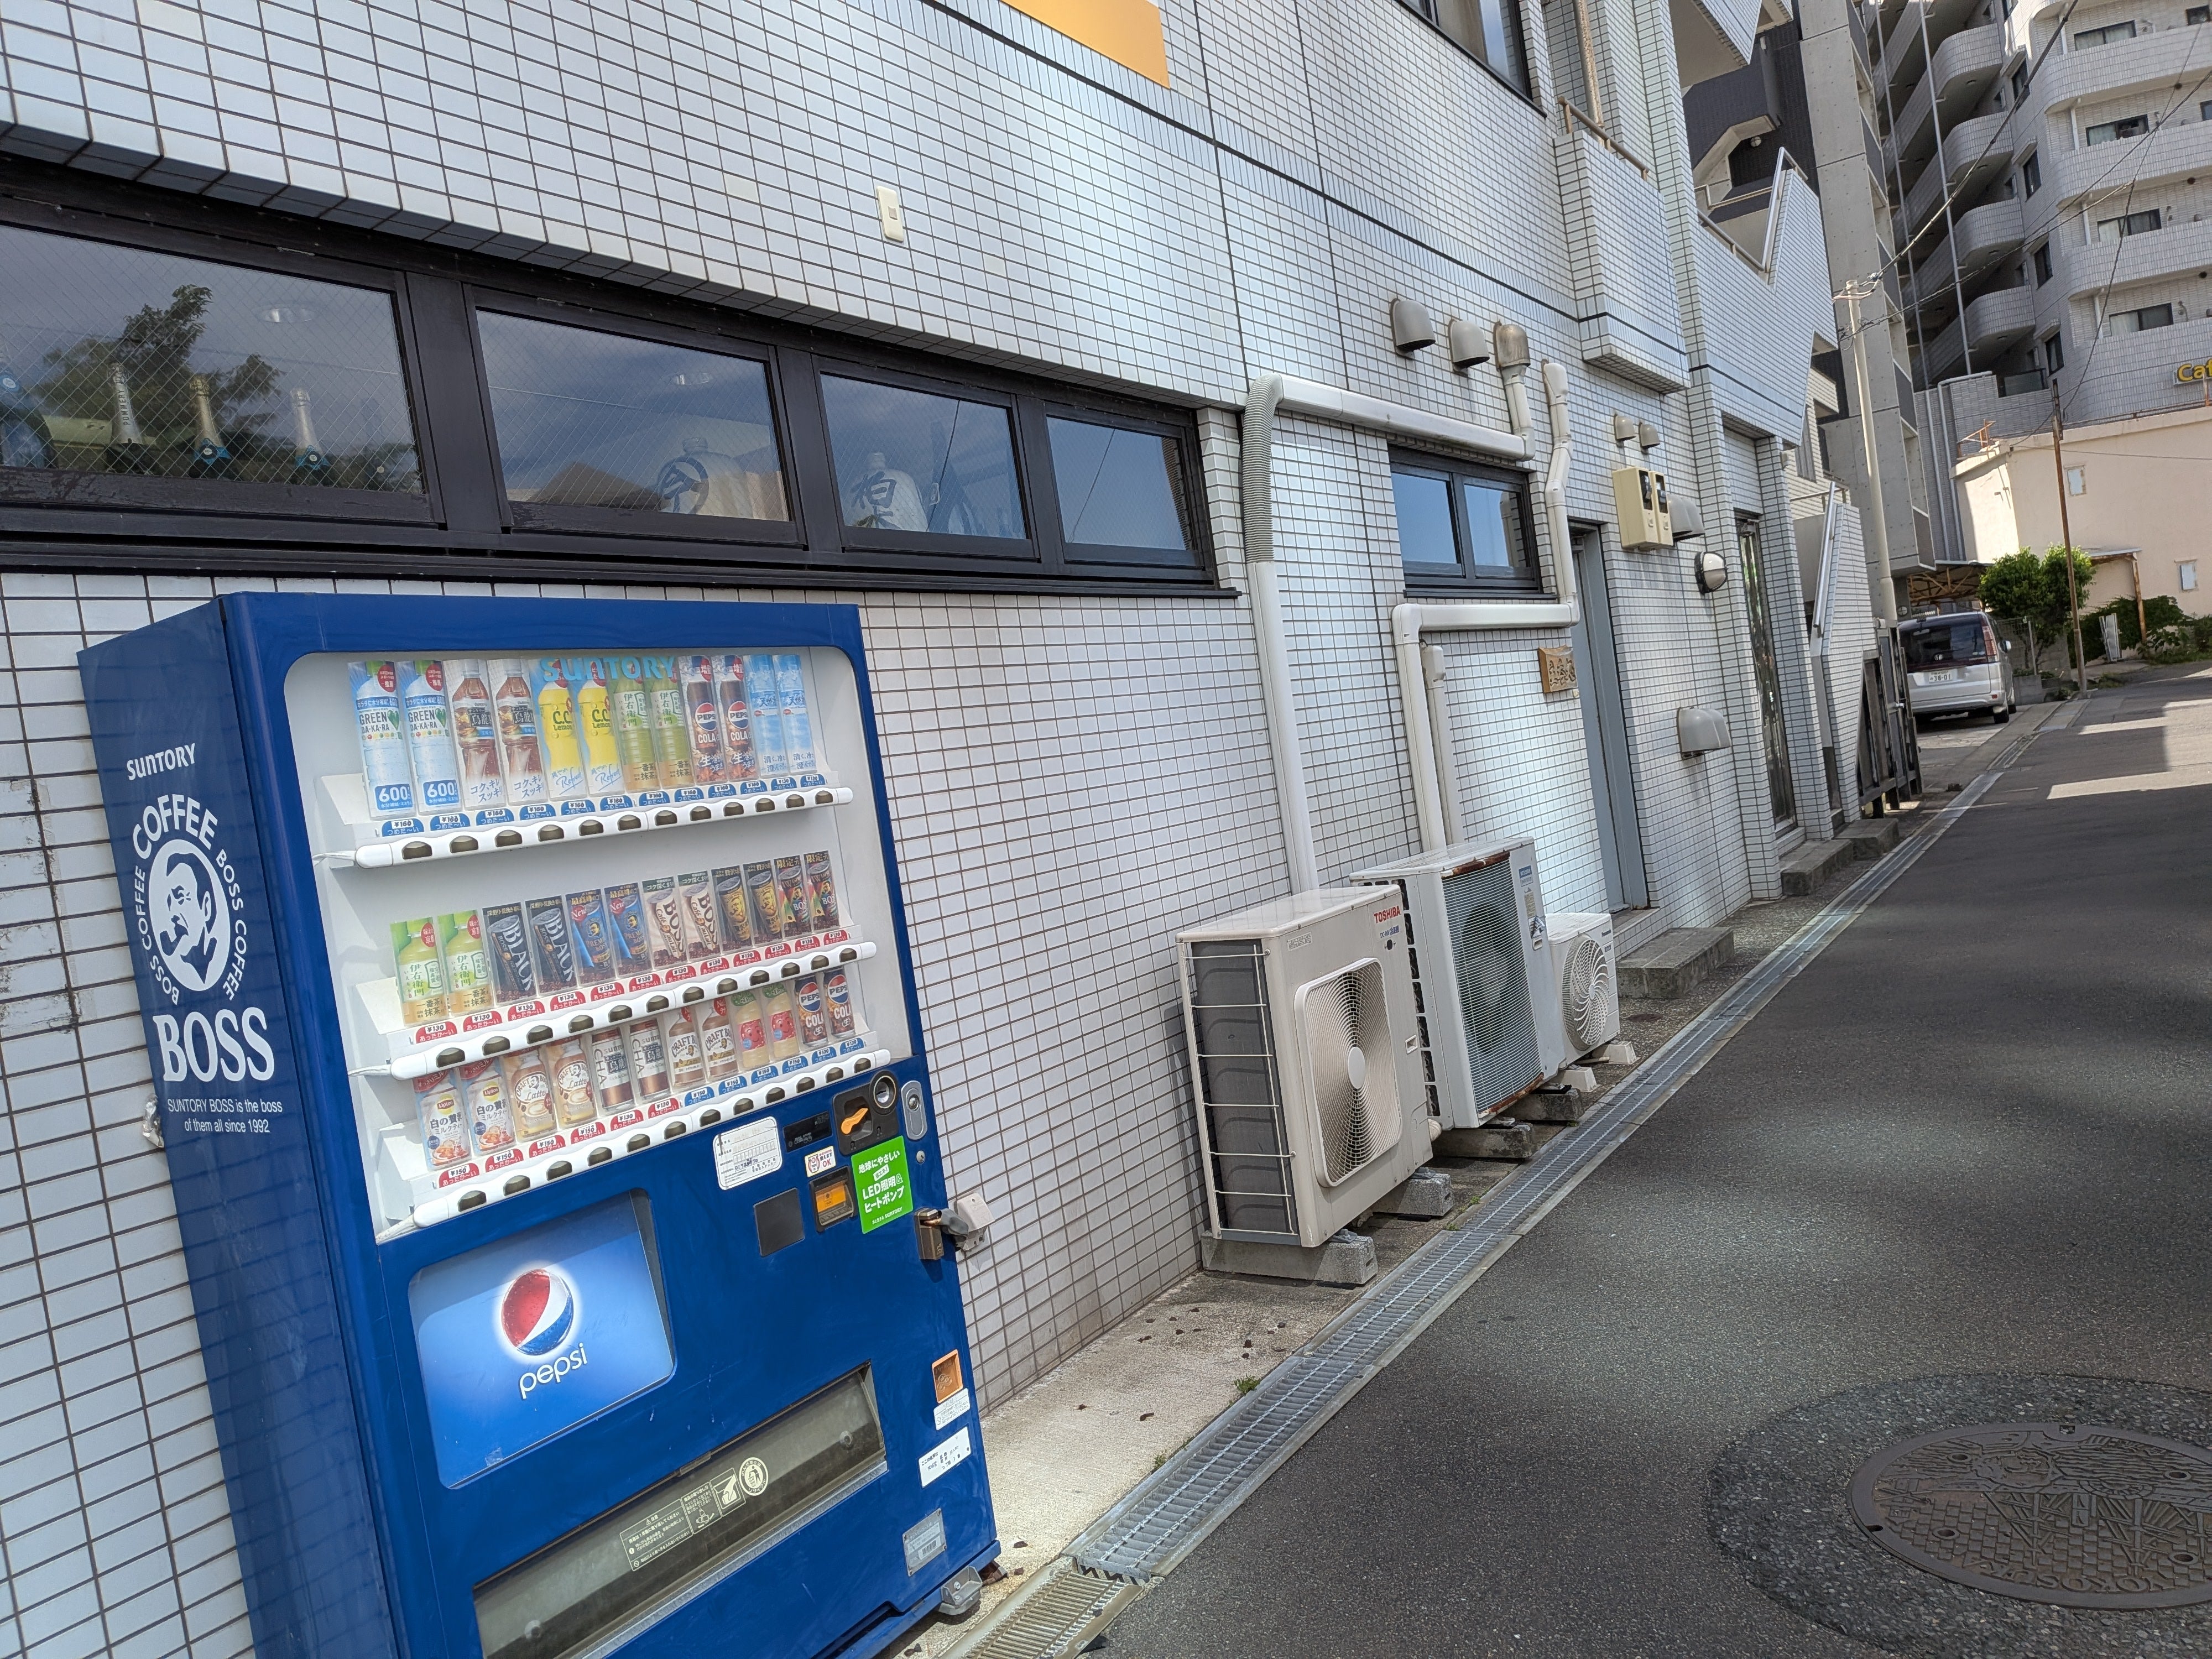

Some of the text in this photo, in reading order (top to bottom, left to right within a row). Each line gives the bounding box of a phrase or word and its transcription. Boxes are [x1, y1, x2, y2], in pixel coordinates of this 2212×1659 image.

[117, 390, 131, 425] POMMERY
[359, 711, 388, 726] GREEN
[408, 709, 435, 723] GREEN
[515, 712, 533, 723] 烏龍
[624, 692, 637, 726] 伊右衛門
[660, 691, 672, 725] 伊右衛門
[472, 713, 492, 726] 烏龍
[697, 733, 716, 744] COLA
[731, 731, 748, 742] COLA
[127, 742, 196, 781] SUNTORY
[132, 794, 218, 860] COFFEE
[571, 908, 587, 919] New
[610, 901, 624, 911] New
[1374, 905, 1401, 924] TOSHIBA
[216, 848, 247, 1001] BOSS COFFEE
[662, 898, 685, 953] BOSS
[698, 892, 718, 945] BOSS
[135, 865, 180, 1006] BOSS COFFEE
[502, 924, 534, 991] BLACK
[544, 917, 574, 982] BLACK
[410, 964, 424, 996] 伊右衛門
[456, 954, 471, 987] 伊右衛門
[427, 1024, 444, 1032] ¥130
[153, 1006, 275, 1083] BOSS
[671, 1035, 690, 1058] CRAFT
[705, 1029, 724, 1051] CRAFT
[594, 1048, 607, 1086] CHA
[632, 1039, 645, 1075] CHA
[516, 1077, 530, 1097] CRAFT
[557, 1067, 572, 1085] CRAFT
[567, 1078, 587, 1090] Latte
[484, 1088, 498, 1096] Lipton
[525, 1089, 546, 1102] Latte
[168, 1098, 283, 1113] SUNTORY BOSS is the boss
[439, 1100, 453, 1109] Lipton
[184, 1118, 270, 1133] of them all since 1992
[822, 1158, 831, 1167] OK
[858, 1150, 900, 1173] 地球にやさしい
[864, 1185, 905, 1213] ヒートポンプ
[885, 1207, 902, 1219] SUNTORY
[519, 1343, 588, 1400] pepsi
[1960, 1557, 2174, 1593] YOKOSUKA
